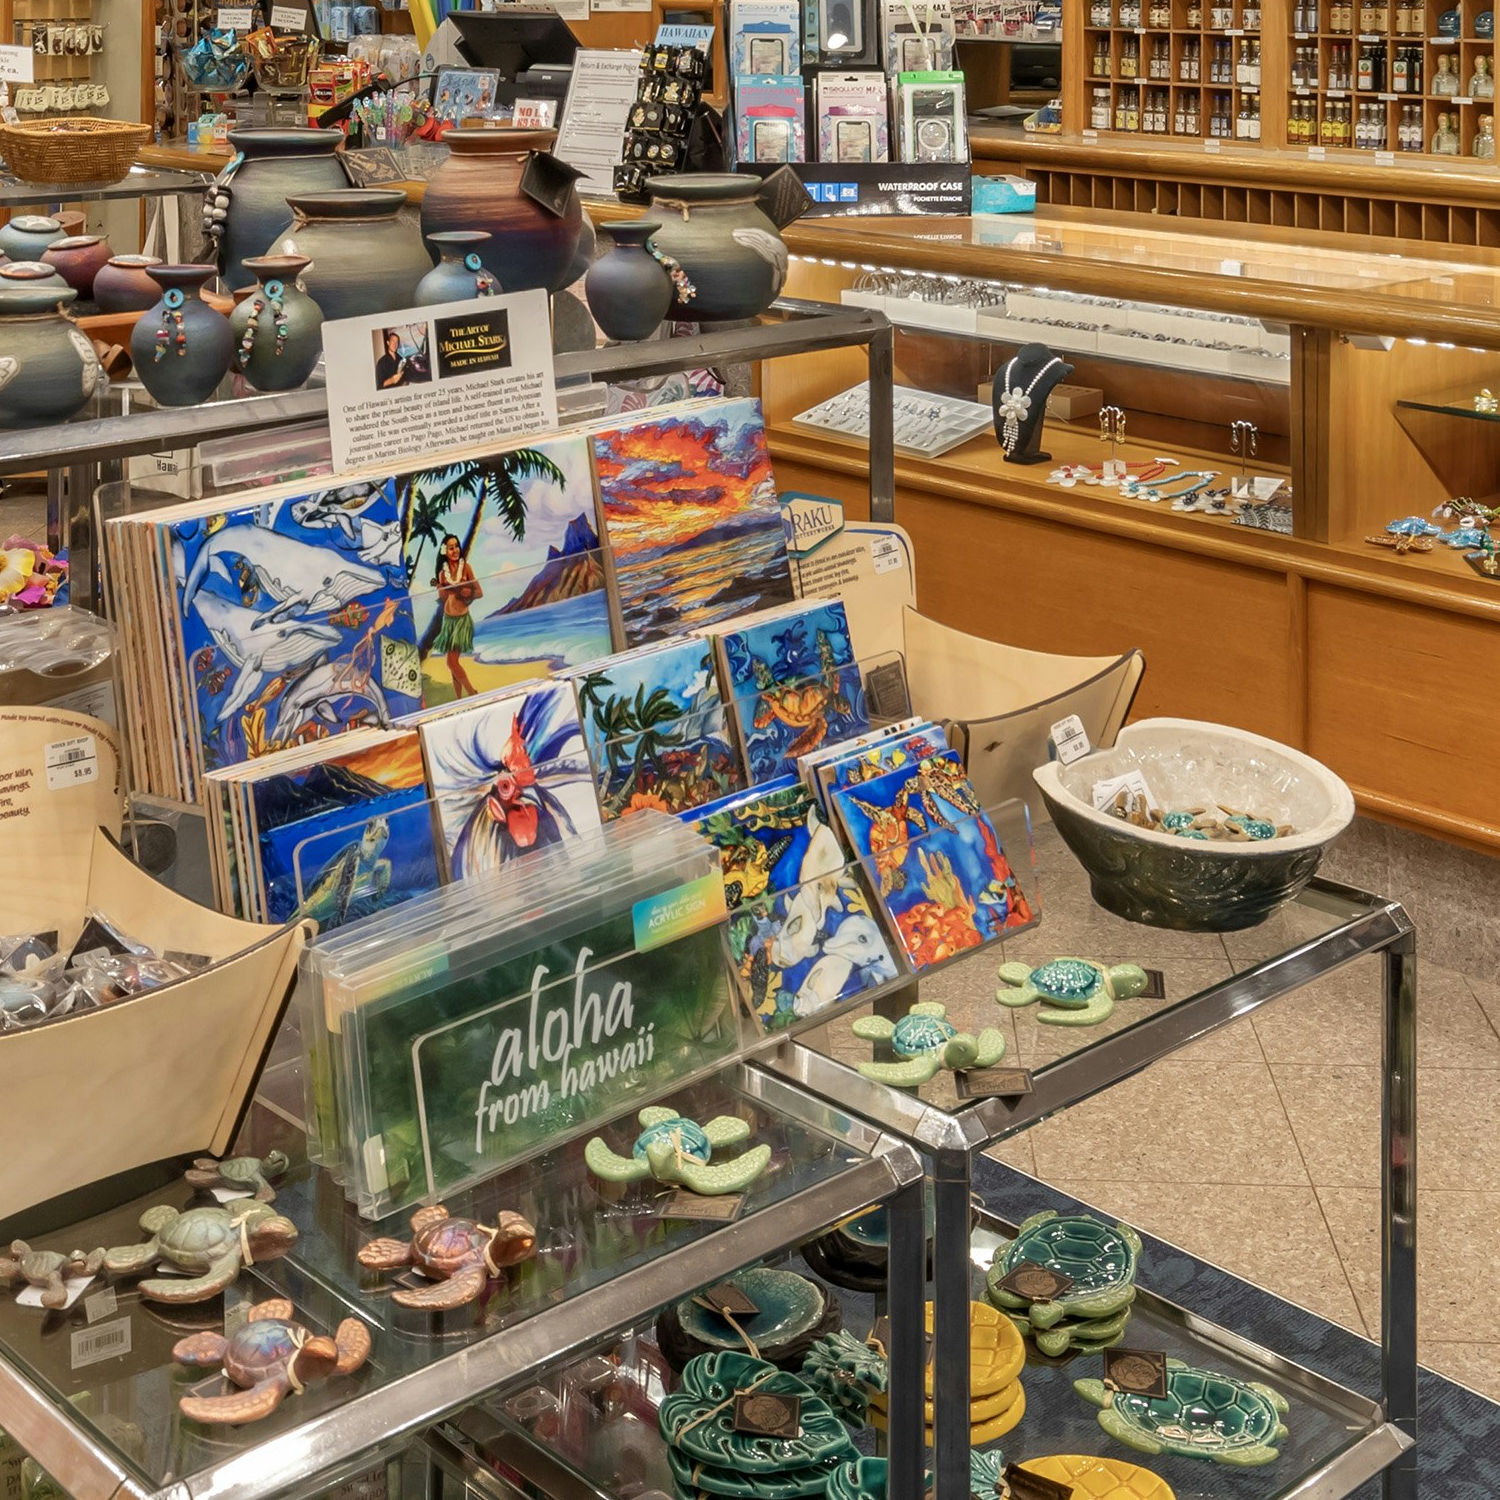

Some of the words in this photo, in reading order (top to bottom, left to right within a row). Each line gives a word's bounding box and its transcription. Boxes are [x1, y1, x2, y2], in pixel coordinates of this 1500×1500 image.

[661, 27, 709, 38] HAWAIIAN
[580, 61, 594, 69] Return
[601, 62, 623, 71] Exchange
[623, 63, 637, 72] Policy
[878, 182, 939, 191] WATERPROOF
[942, 182, 963, 190] CASE
[480, 324, 490, 333] OF
[440, 338, 478, 352] MICHAEL
[479, 335, 506, 347] STARK
[451, 358, 468, 367] MADE
[343, 405, 356, 414] One
[357, 402, 366, 410] of
[366, 398, 393, 410] Hawaii's
[413, 392, 422, 401] for
[423, 391, 437, 399] over
[466, 381, 489, 391] Michael
[490, 378, 505, 387] Stark
[506, 375, 526, 384] creates
[536, 371, 544, 379] art
[793, 505, 833, 533] RAKU
[14, 768, 34, 780] kiln,
[648, 907, 684, 930] ACRYLIC
[685, 899, 707, 914] SIGN
[491, 947, 636, 1087] aloha
[474, 1078, 551, 1155] from
[561, 1023, 656, 1100] hawaii
